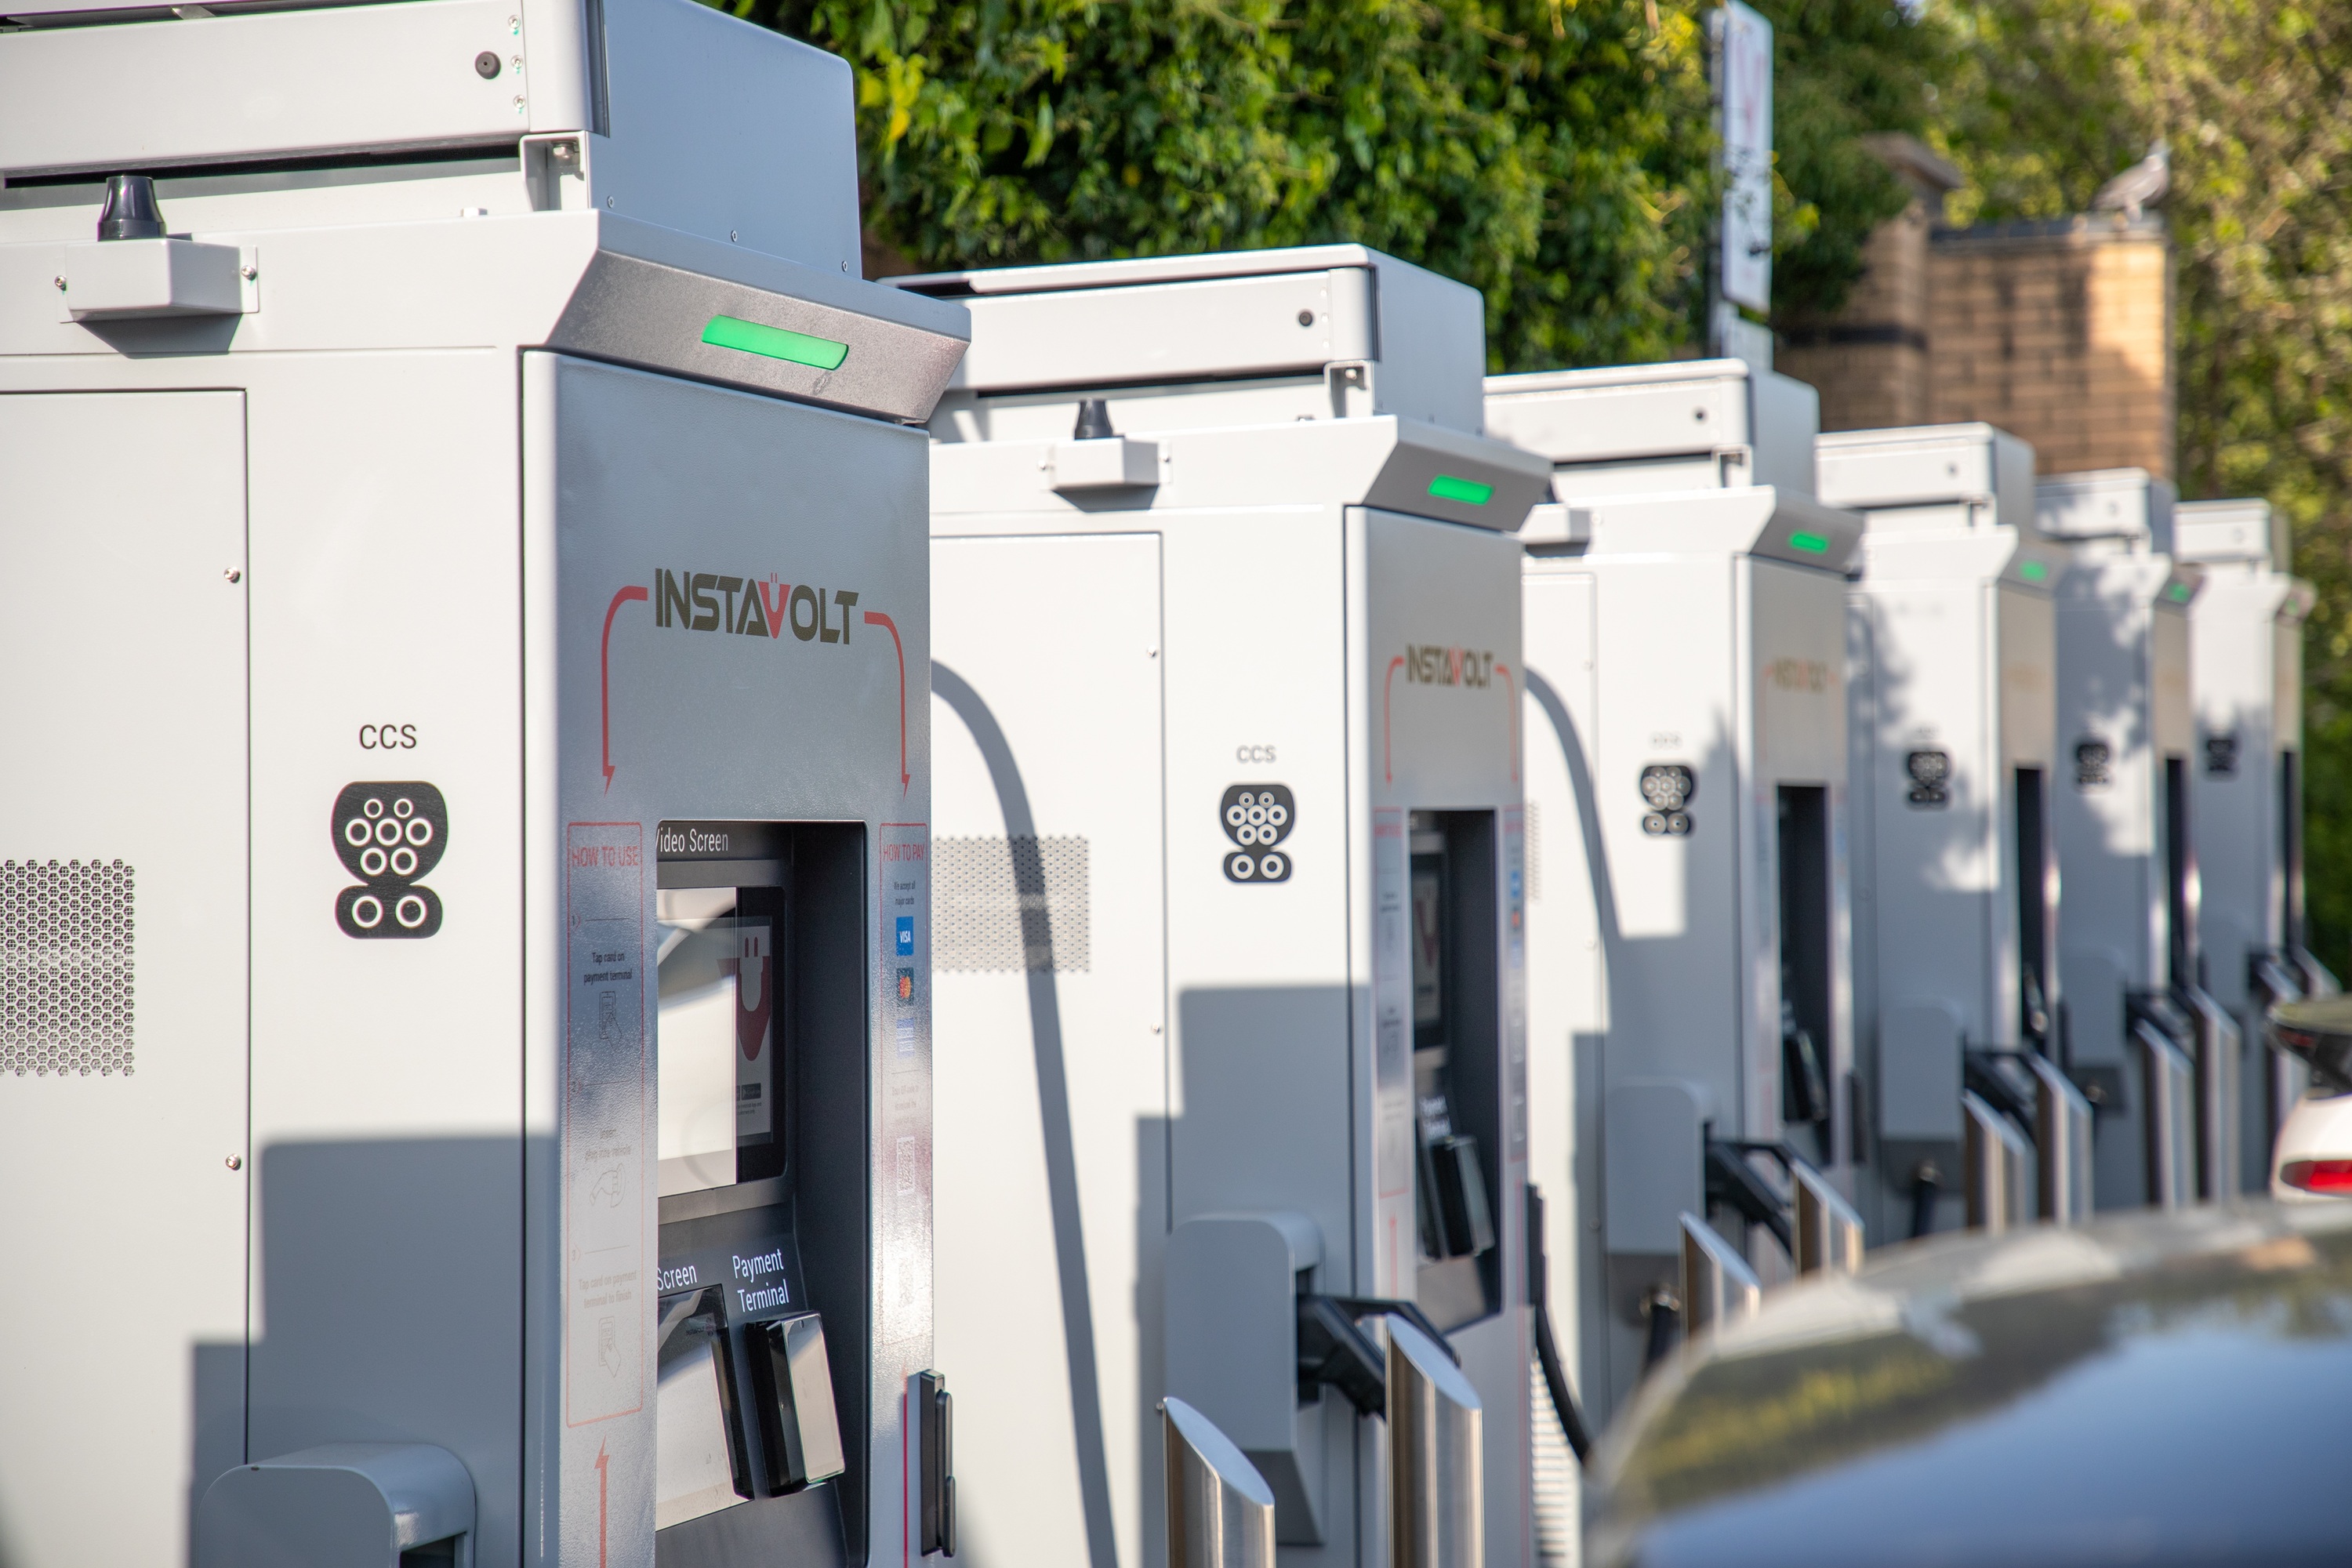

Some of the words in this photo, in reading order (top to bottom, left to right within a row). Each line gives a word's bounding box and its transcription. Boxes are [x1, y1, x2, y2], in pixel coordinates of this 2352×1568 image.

[655, 568, 859, 644] INSTAVOLT
[1406, 644, 1494, 689] INSTAVOLT
[358, 724, 417, 750] CCS
[1236, 745, 1276, 764] CCS
[689, 828, 728, 853] Screen
[572, 847, 598, 866] HOW
[602, 847, 615, 866] TO
[619, 846, 638, 866] USE
[883, 844, 900, 861] HOW
[902, 844, 911, 861] TO
[913, 844, 924, 861] PAY
[899, 931, 911, 943] VISA
[592, 952, 603, 965] Tap
[604, 951, 616, 962] card
[617, 953, 625, 962] on
[583, 971, 609, 985] payment
[610, 968, 633, 981] terminal
[732, 1249, 784, 1283] Payment
[579, 1279, 589, 1292] Tap
[590, 1274, 603, 1287] card
[604, 1276, 612, 1285] on
[613, 1270, 637, 1287] payment
[657, 1265, 697, 1291] Screen
[584, 1292, 608, 1308] terminal
[608, 1293, 614, 1304] to
[616, 1289, 632, 1302] finish
[737, 1279, 789, 1312] Terminal
